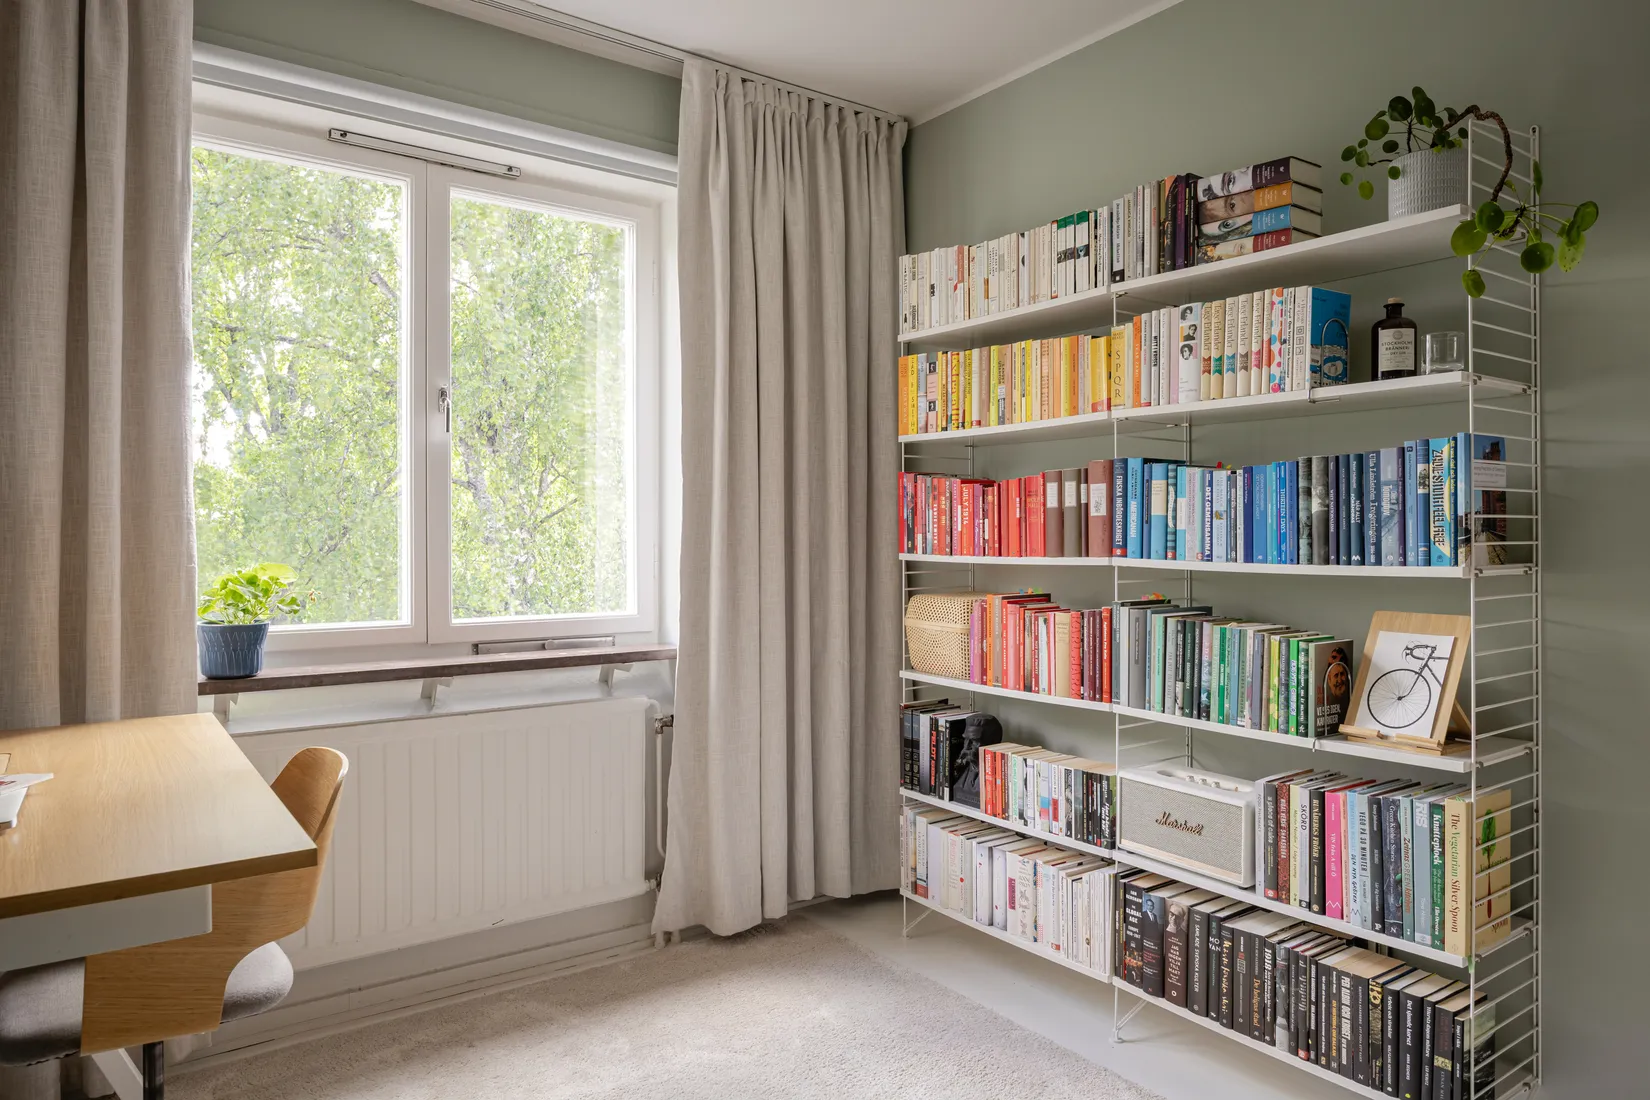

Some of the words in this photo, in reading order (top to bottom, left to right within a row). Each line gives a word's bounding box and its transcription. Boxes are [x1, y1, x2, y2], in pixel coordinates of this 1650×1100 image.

[1203, 305, 1212, 321] Tage
[1213, 302, 1223, 320] Tage
[1225, 299, 1235, 317] Tage
[1239, 297, 1248, 316] Tage
[1203, 322, 1212, 352] Erlander
[1213, 320, 1223, 352] Erlander
[1225, 318, 1235, 349] Erlander
[1239, 316, 1248, 347] Erlander
[1369, 453, 1378, 467] Ulla
[1115, 475, 1123, 497] FINSKA
[1369, 468, 1378, 500] Lindström
[1115, 498, 1123, 546] INBÖRDESKRIGET
[1369, 507, 1378, 543] regeringen
[1071, 616, 1081, 651] KARL
[1071, 654, 1081, 698] MARX
[1154, 811, 1205, 837] Marshall
[1267, 820, 1274, 828] of
[1300, 804, 1308, 831] SKÖRD
[1360, 811, 1368, 827] VEGO
[1449, 813, 1460, 830] The
[1360, 828, 1368, 836] PÅ
[1360, 837, 1368, 845] 30
[1431, 814, 1442, 865] Knatteplock
[1360, 847, 1368, 872] MINUTER
[1403, 837, 1411, 862] Zeinas
[1449, 831, 1460, 877] Vegetarian
[1403, 862, 1411, 888] GREEN
[1126, 893, 1142, 904] KERSHAW
[1403, 888, 1411, 914] kitchen
[1449, 878, 1460, 904] Silver
[1126, 907, 1142, 918] GLOBAL
[1129, 916, 1138, 924] AGE
[1449, 905, 1460, 933] Spoon
[1168, 953, 1182, 962] INGEN
[1168, 967, 1181, 976] MAKT
[1341, 975, 1351, 987] PER
[1253, 978, 1261, 988] De
[1253, 988, 1261, 1012] heligas
[1341, 987, 1351, 1005] ALBIN
[1253, 1012, 1261, 1027] stad
[1341, 1005, 1351, 1018] OCH
[1341, 1018, 1351, 1040] KRIGET
